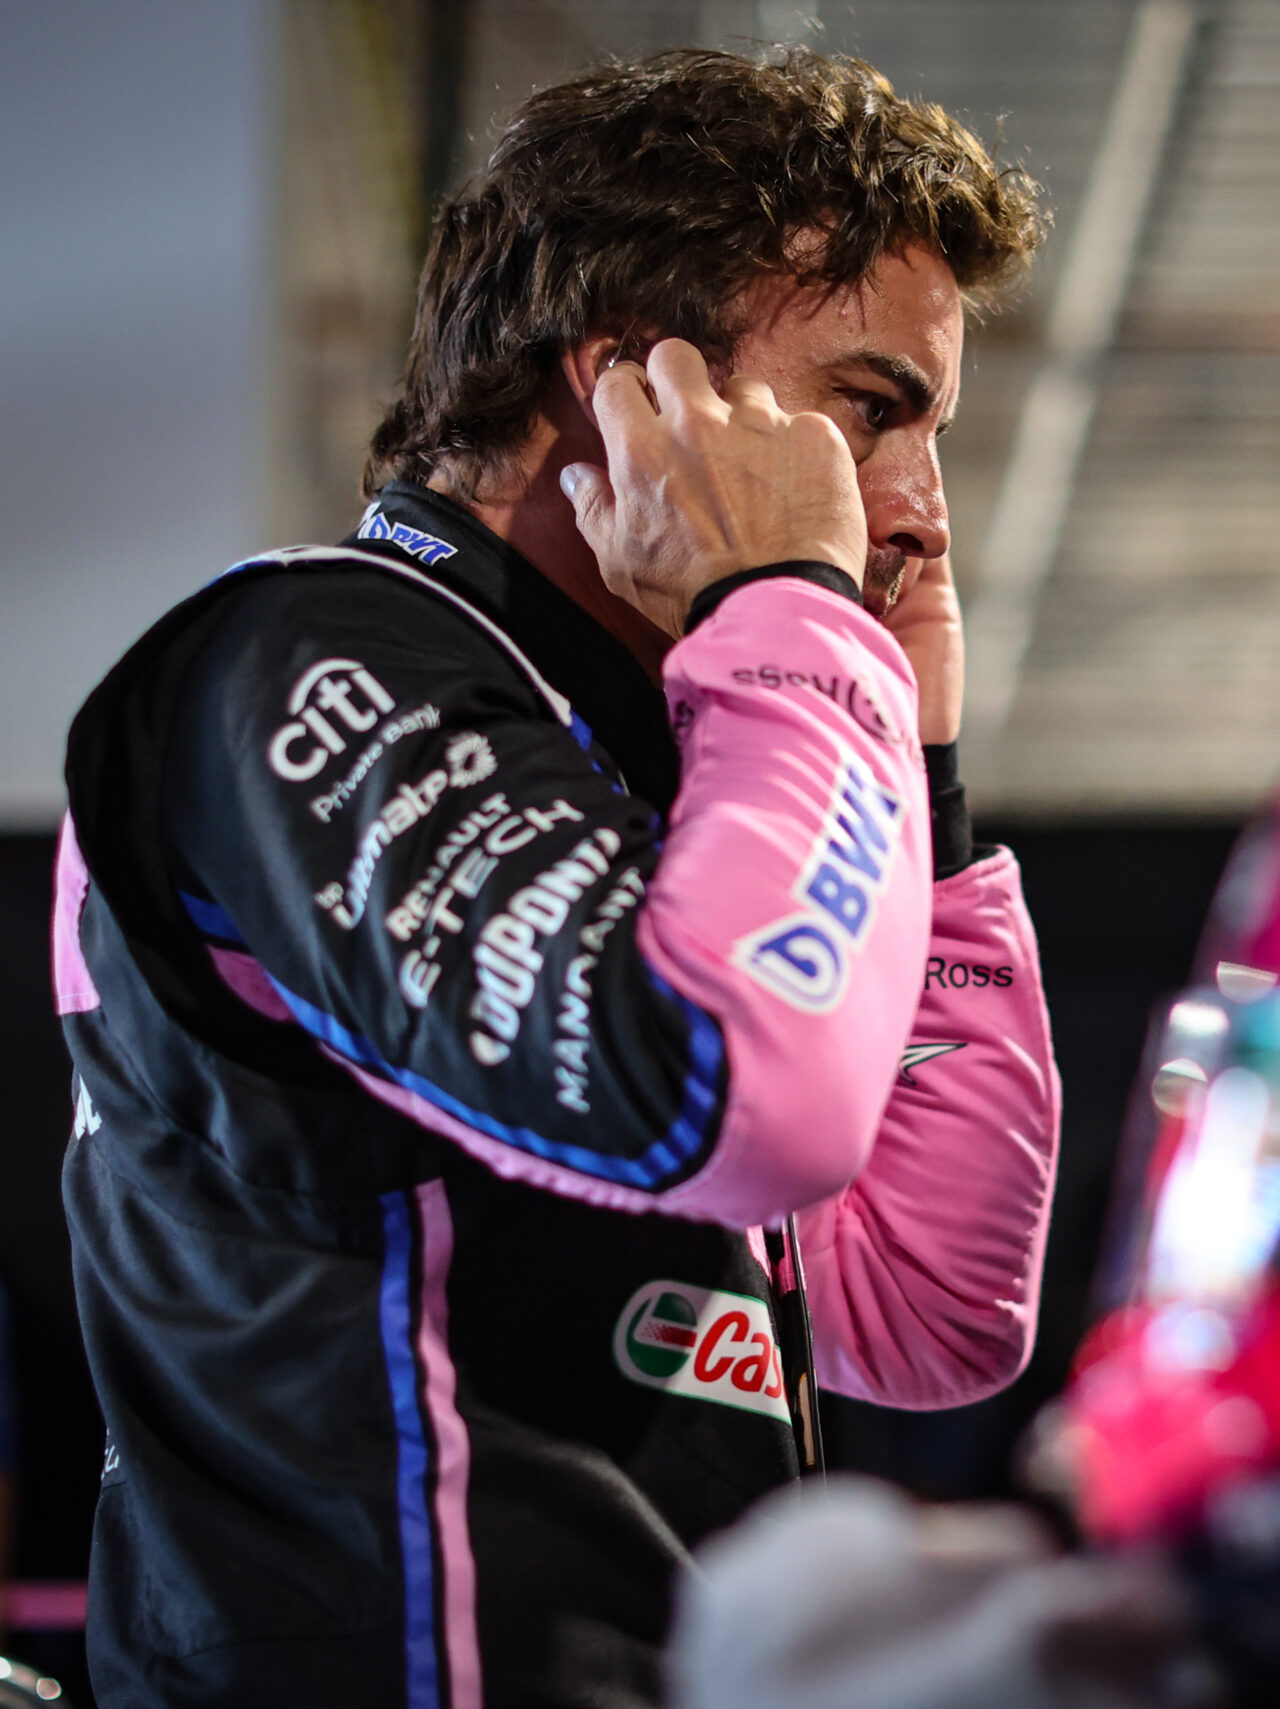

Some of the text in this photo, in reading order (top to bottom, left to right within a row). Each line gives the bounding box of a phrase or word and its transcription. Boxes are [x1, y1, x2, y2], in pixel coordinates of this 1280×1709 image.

[268, 658, 397, 783] citi
[310, 703, 441, 824] Private Bank
[385, 792, 512, 942] RENAULT
[398, 799, 586, 1009] E-TECH
[470, 837, 611, 1042] DUPONT
[924, 956, 1014, 990] Ross
